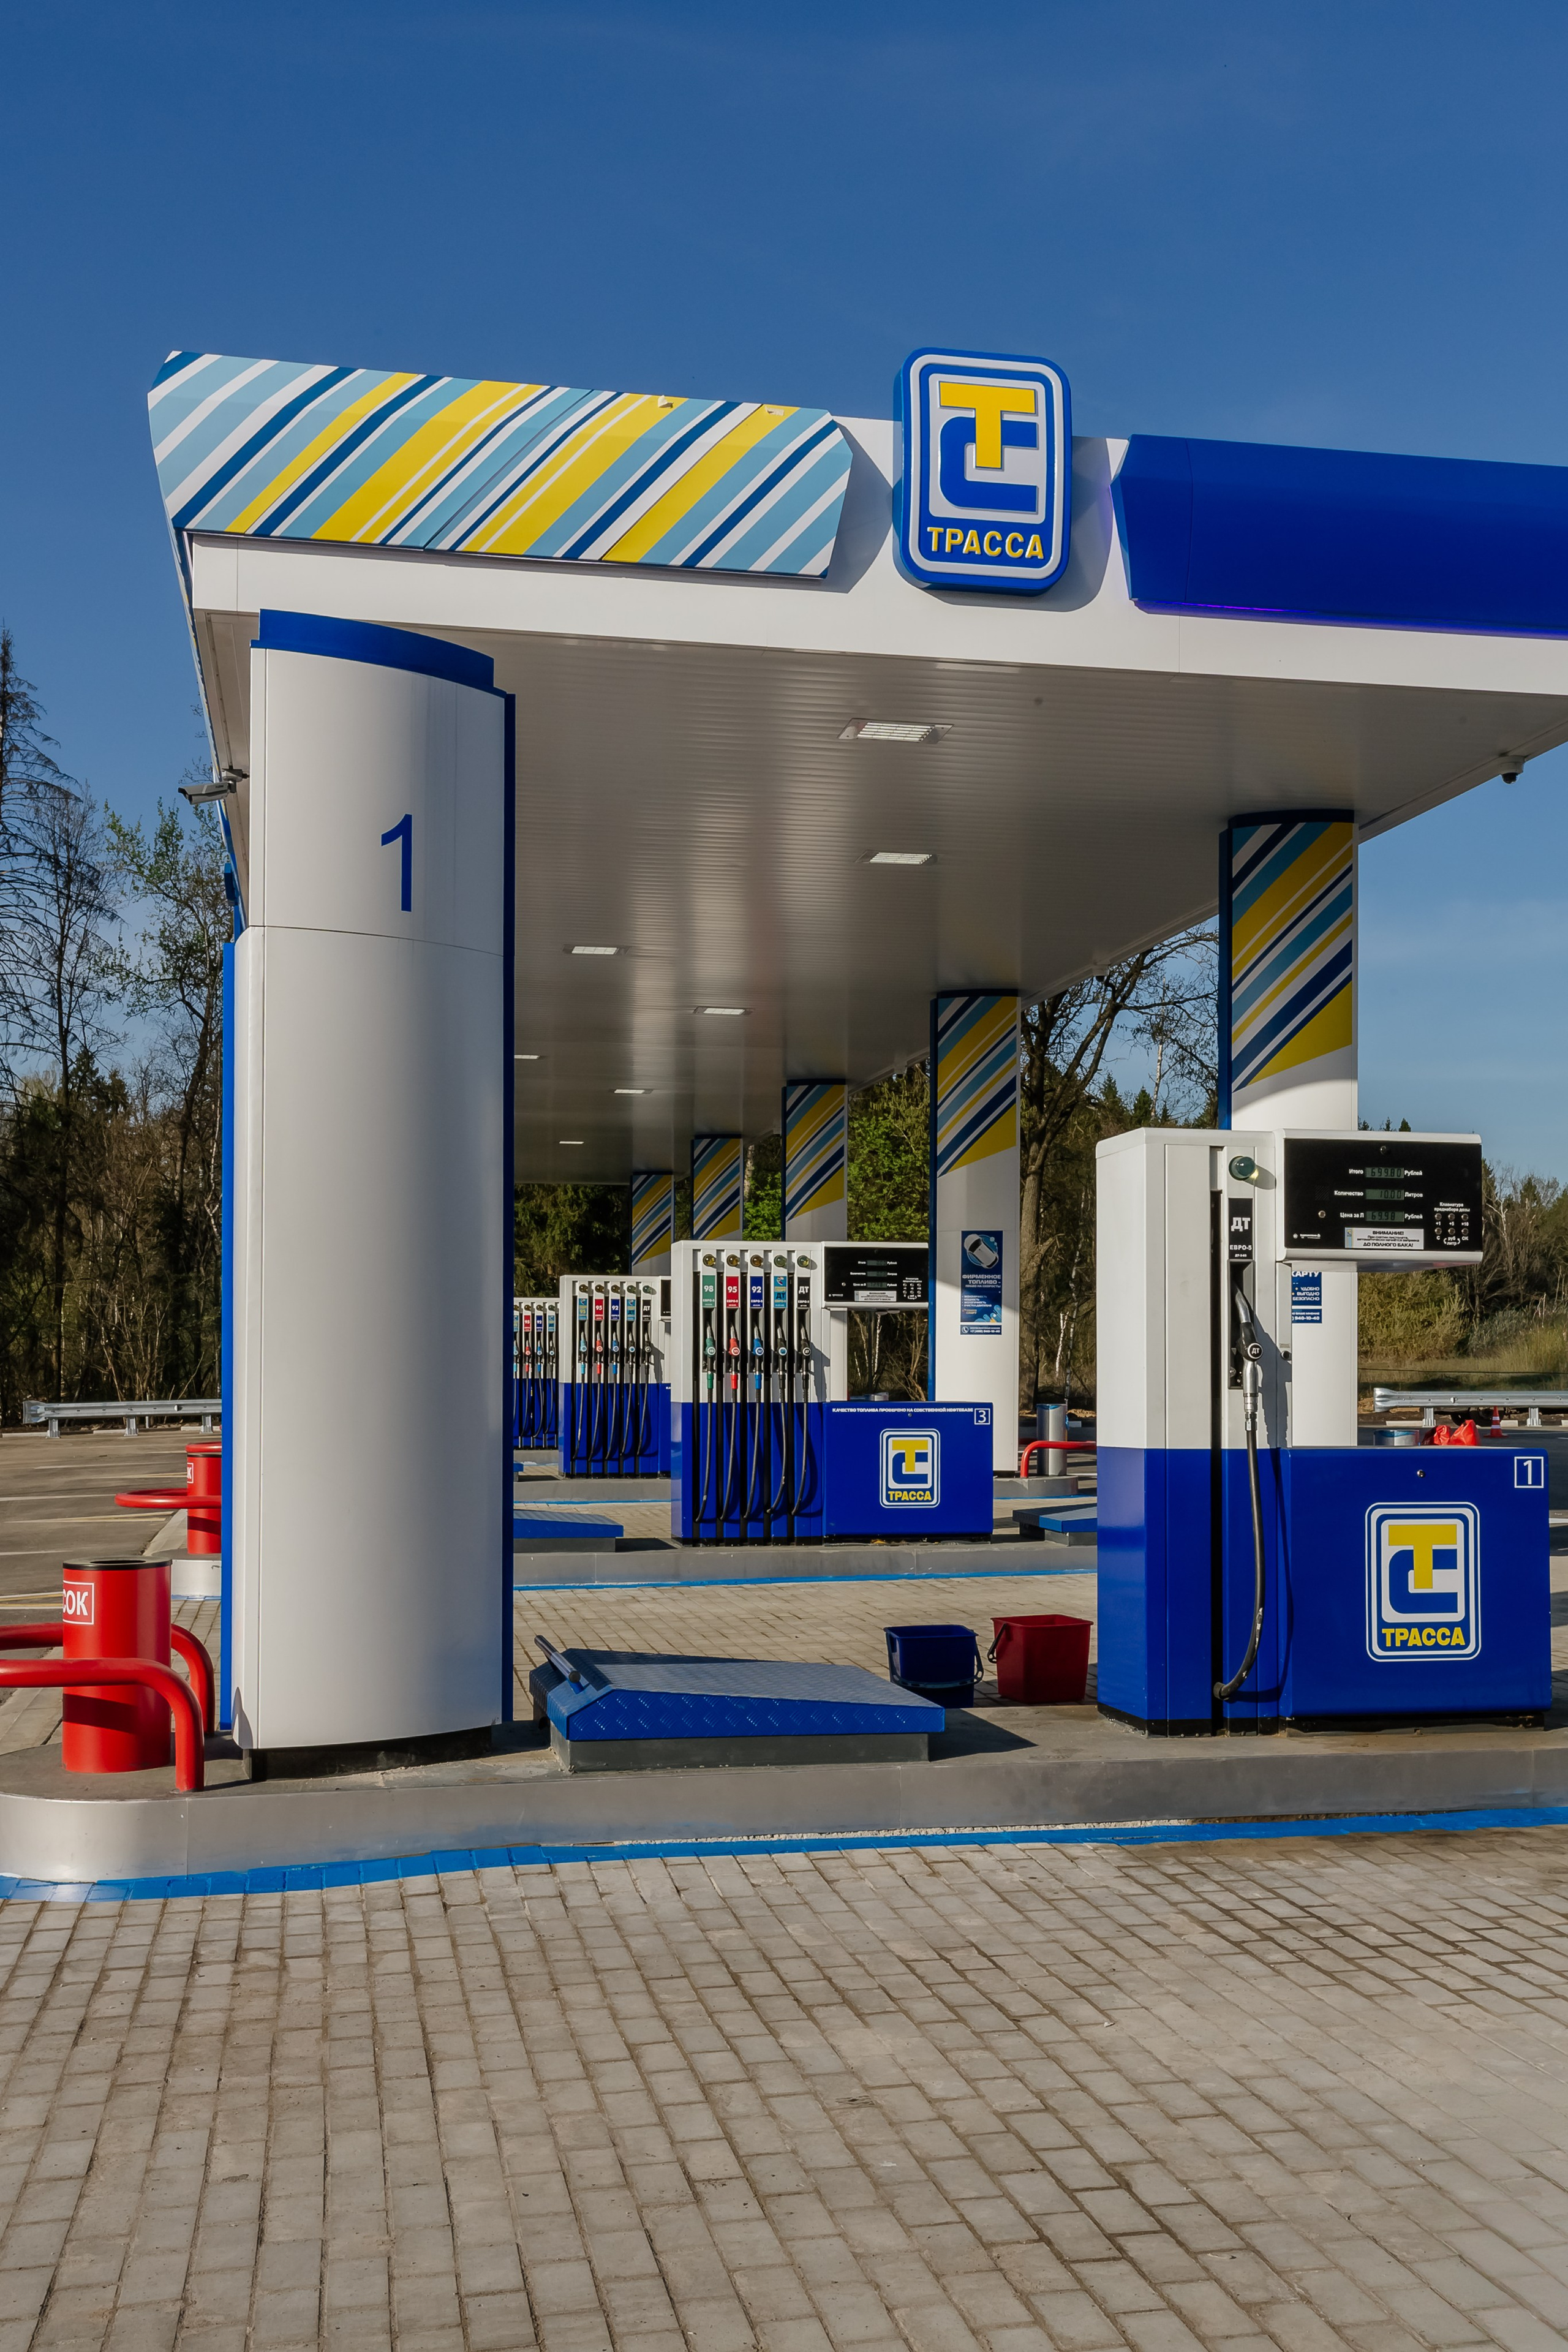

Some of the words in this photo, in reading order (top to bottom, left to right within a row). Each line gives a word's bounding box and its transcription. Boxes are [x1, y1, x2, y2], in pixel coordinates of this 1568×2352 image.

[927, 527, 1044, 560] ТРАССА
[380, 813, 413, 913] 1
[1231, 1217, 1251, 1232] ДТ
[799, 1286, 809, 1294] ДТ
[978, 1410, 987, 1423] 3
[1523, 1460, 1532, 1485] 1
[888, 1491, 932, 1501] ТРАССА
[1382, 1627, 1466, 1647] ТРАССА
